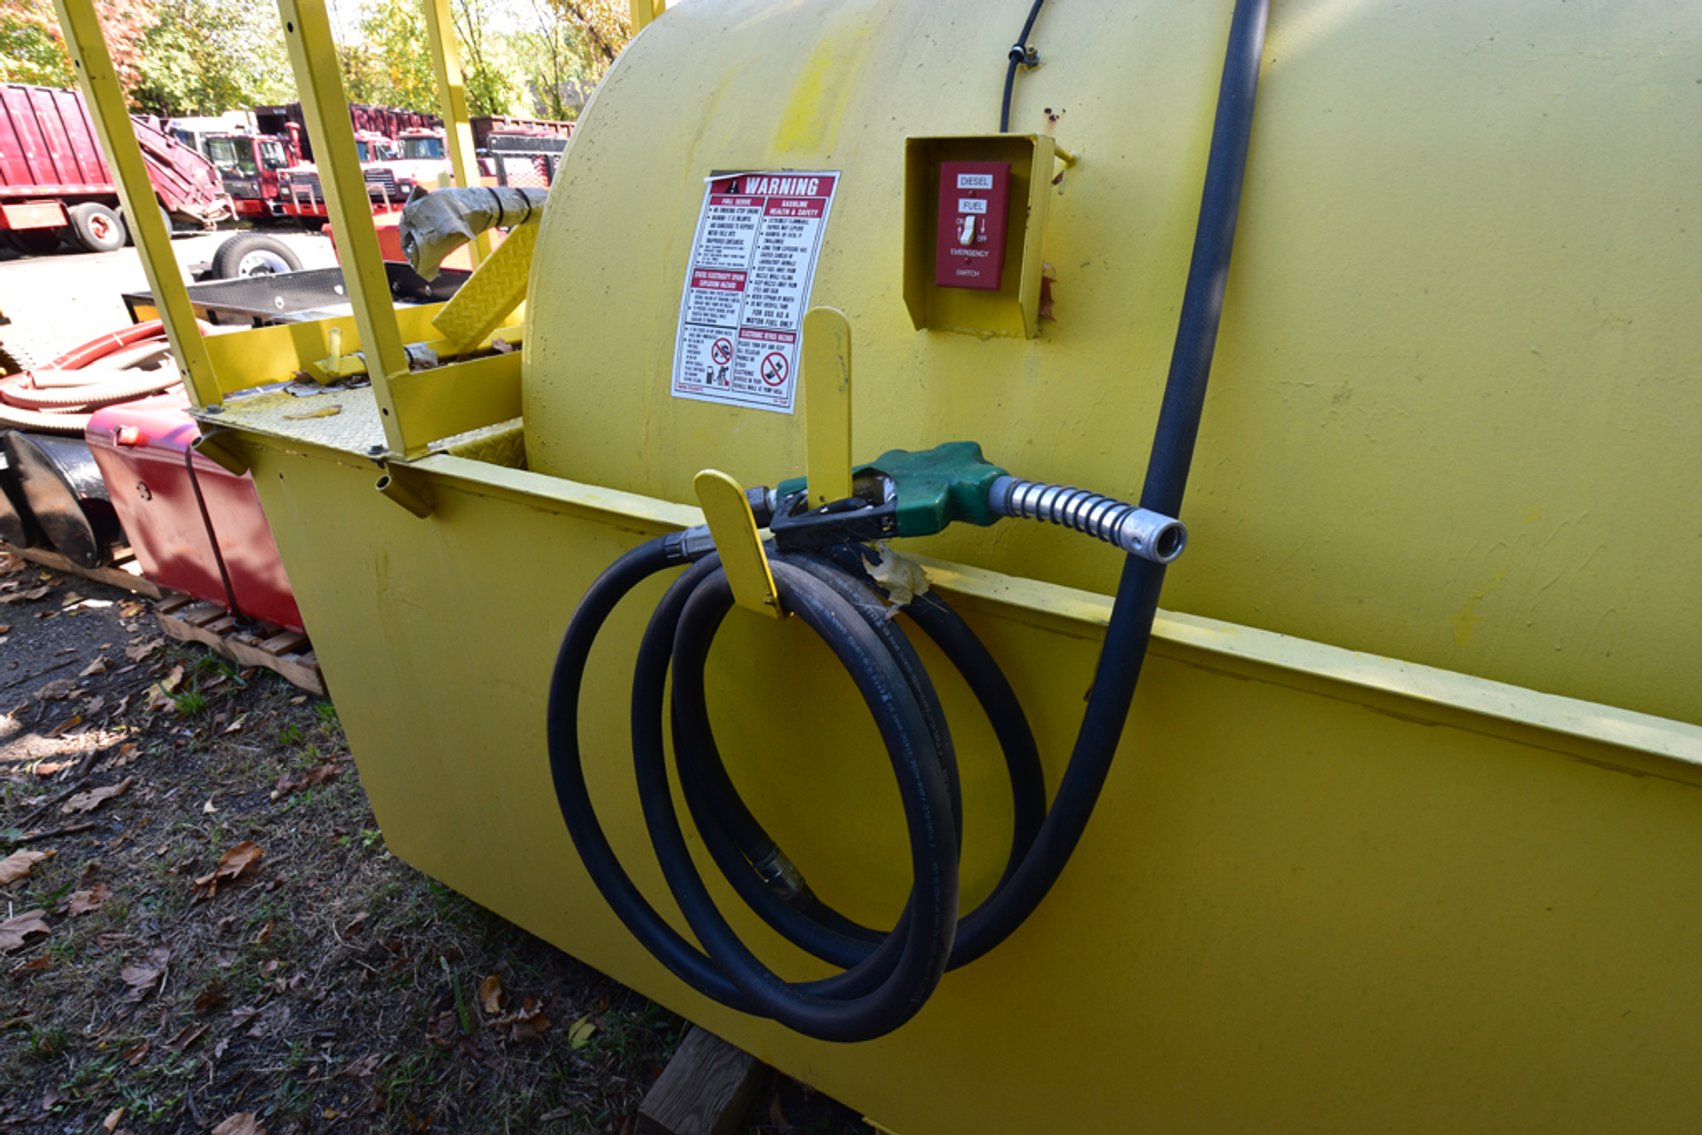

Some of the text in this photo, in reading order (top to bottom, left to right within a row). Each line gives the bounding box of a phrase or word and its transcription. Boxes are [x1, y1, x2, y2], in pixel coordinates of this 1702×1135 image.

[745, 177, 819, 195] WARNING
[960, 176, 988, 186] DIESEL
[963, 201, 983, 211] FUEL
[950, 248, 990, 257] EMERGENCY
[956, 269, 980, 277] SWITCH
[766, 318, 778, 326] FUEL
[780, 320, 793, 328] ONLY
